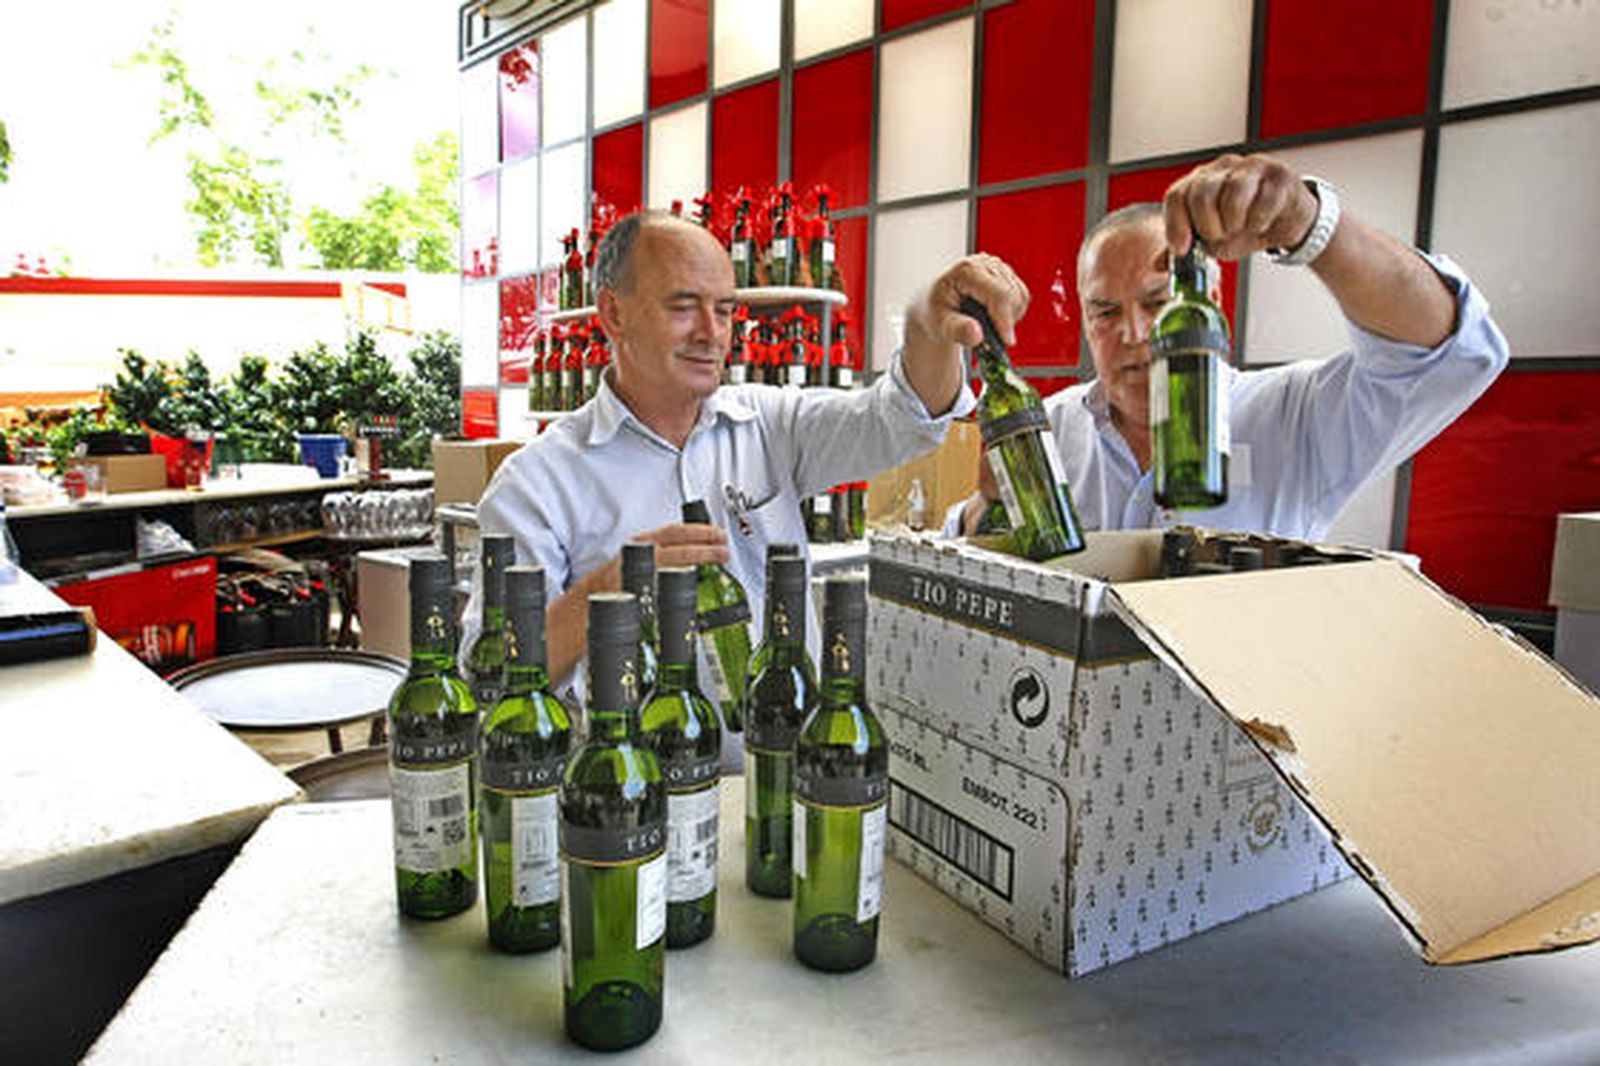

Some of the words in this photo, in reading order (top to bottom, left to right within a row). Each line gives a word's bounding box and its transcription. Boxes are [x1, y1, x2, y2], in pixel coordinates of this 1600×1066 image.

[910, 575, 948, 605] TIO
[955, 588, 1014, 628] PEPE
[624, 828, 664, 853] TIO
